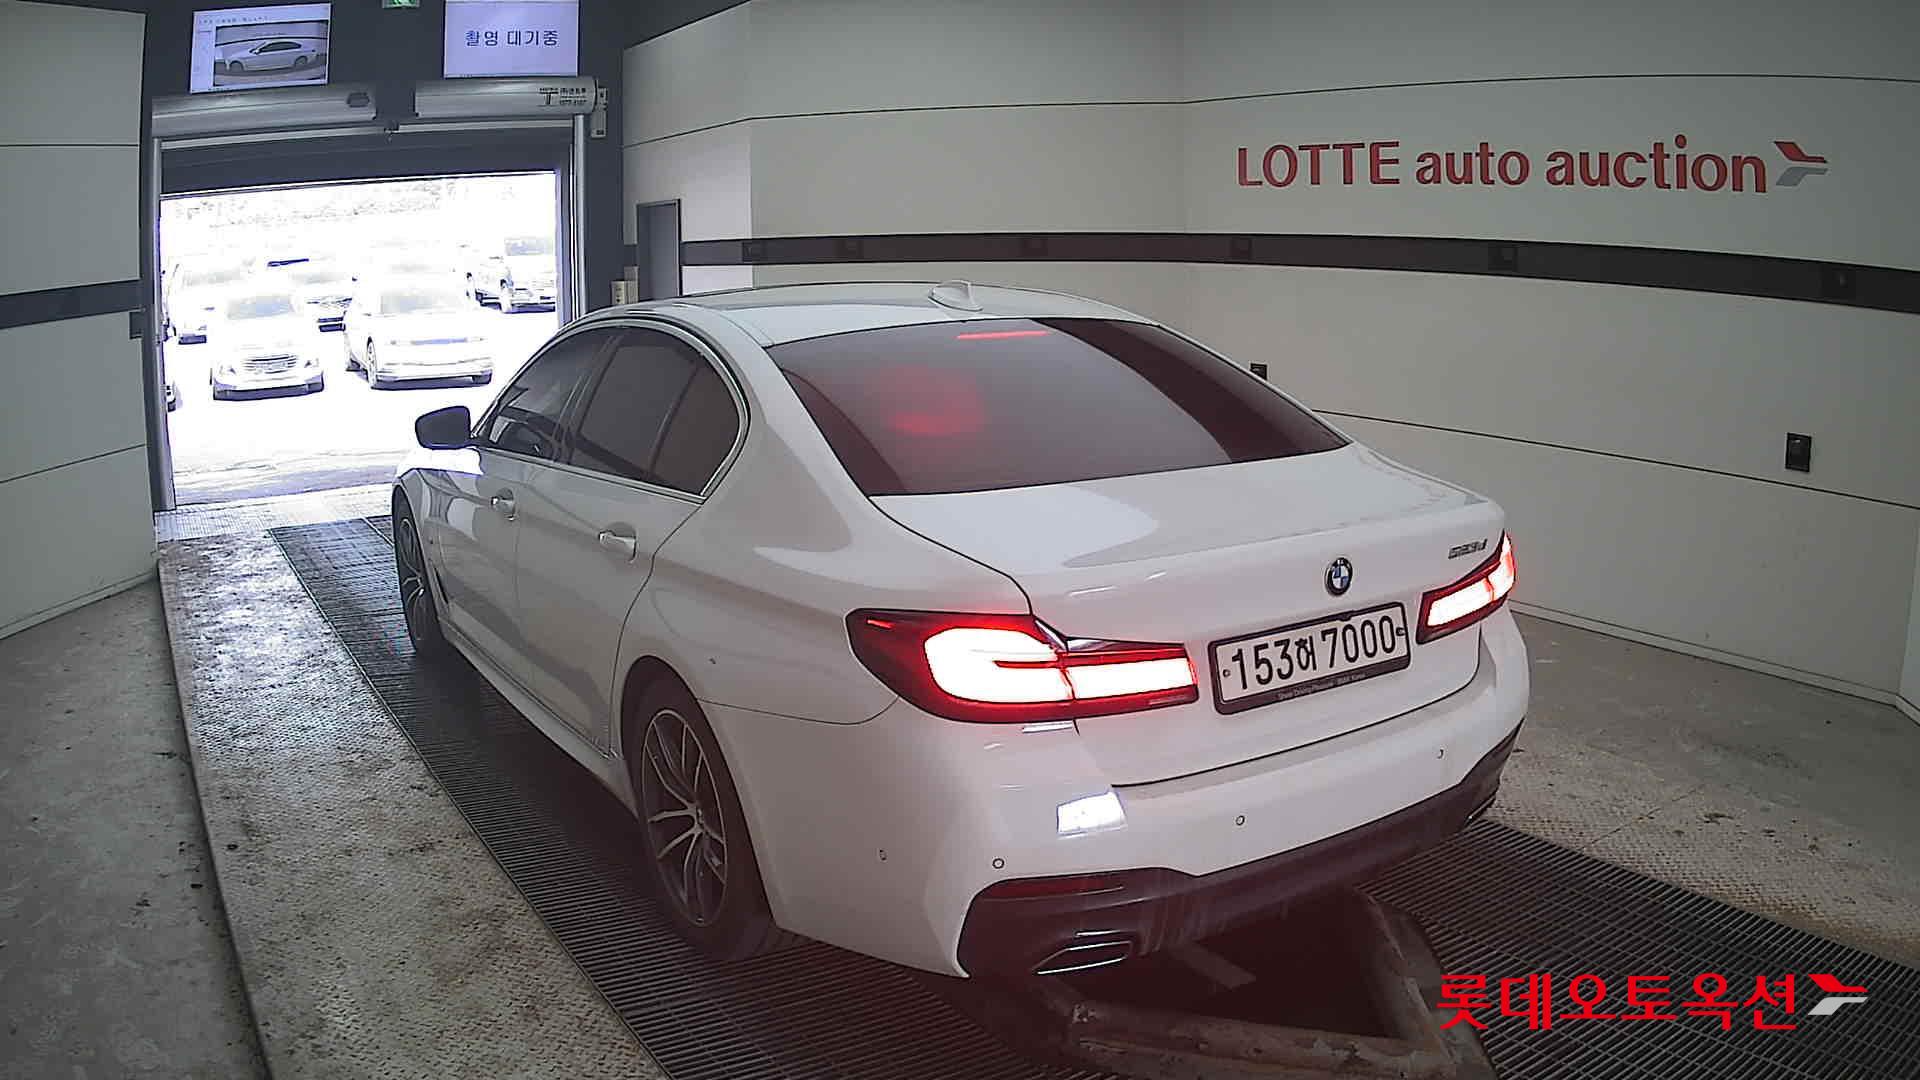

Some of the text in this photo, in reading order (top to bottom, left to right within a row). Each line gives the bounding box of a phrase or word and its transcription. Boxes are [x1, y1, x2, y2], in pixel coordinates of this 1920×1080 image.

[465, 29, 559, 47] 촬영 대기중
[1237, 133, 1768, 193] LOTTE auto auction
